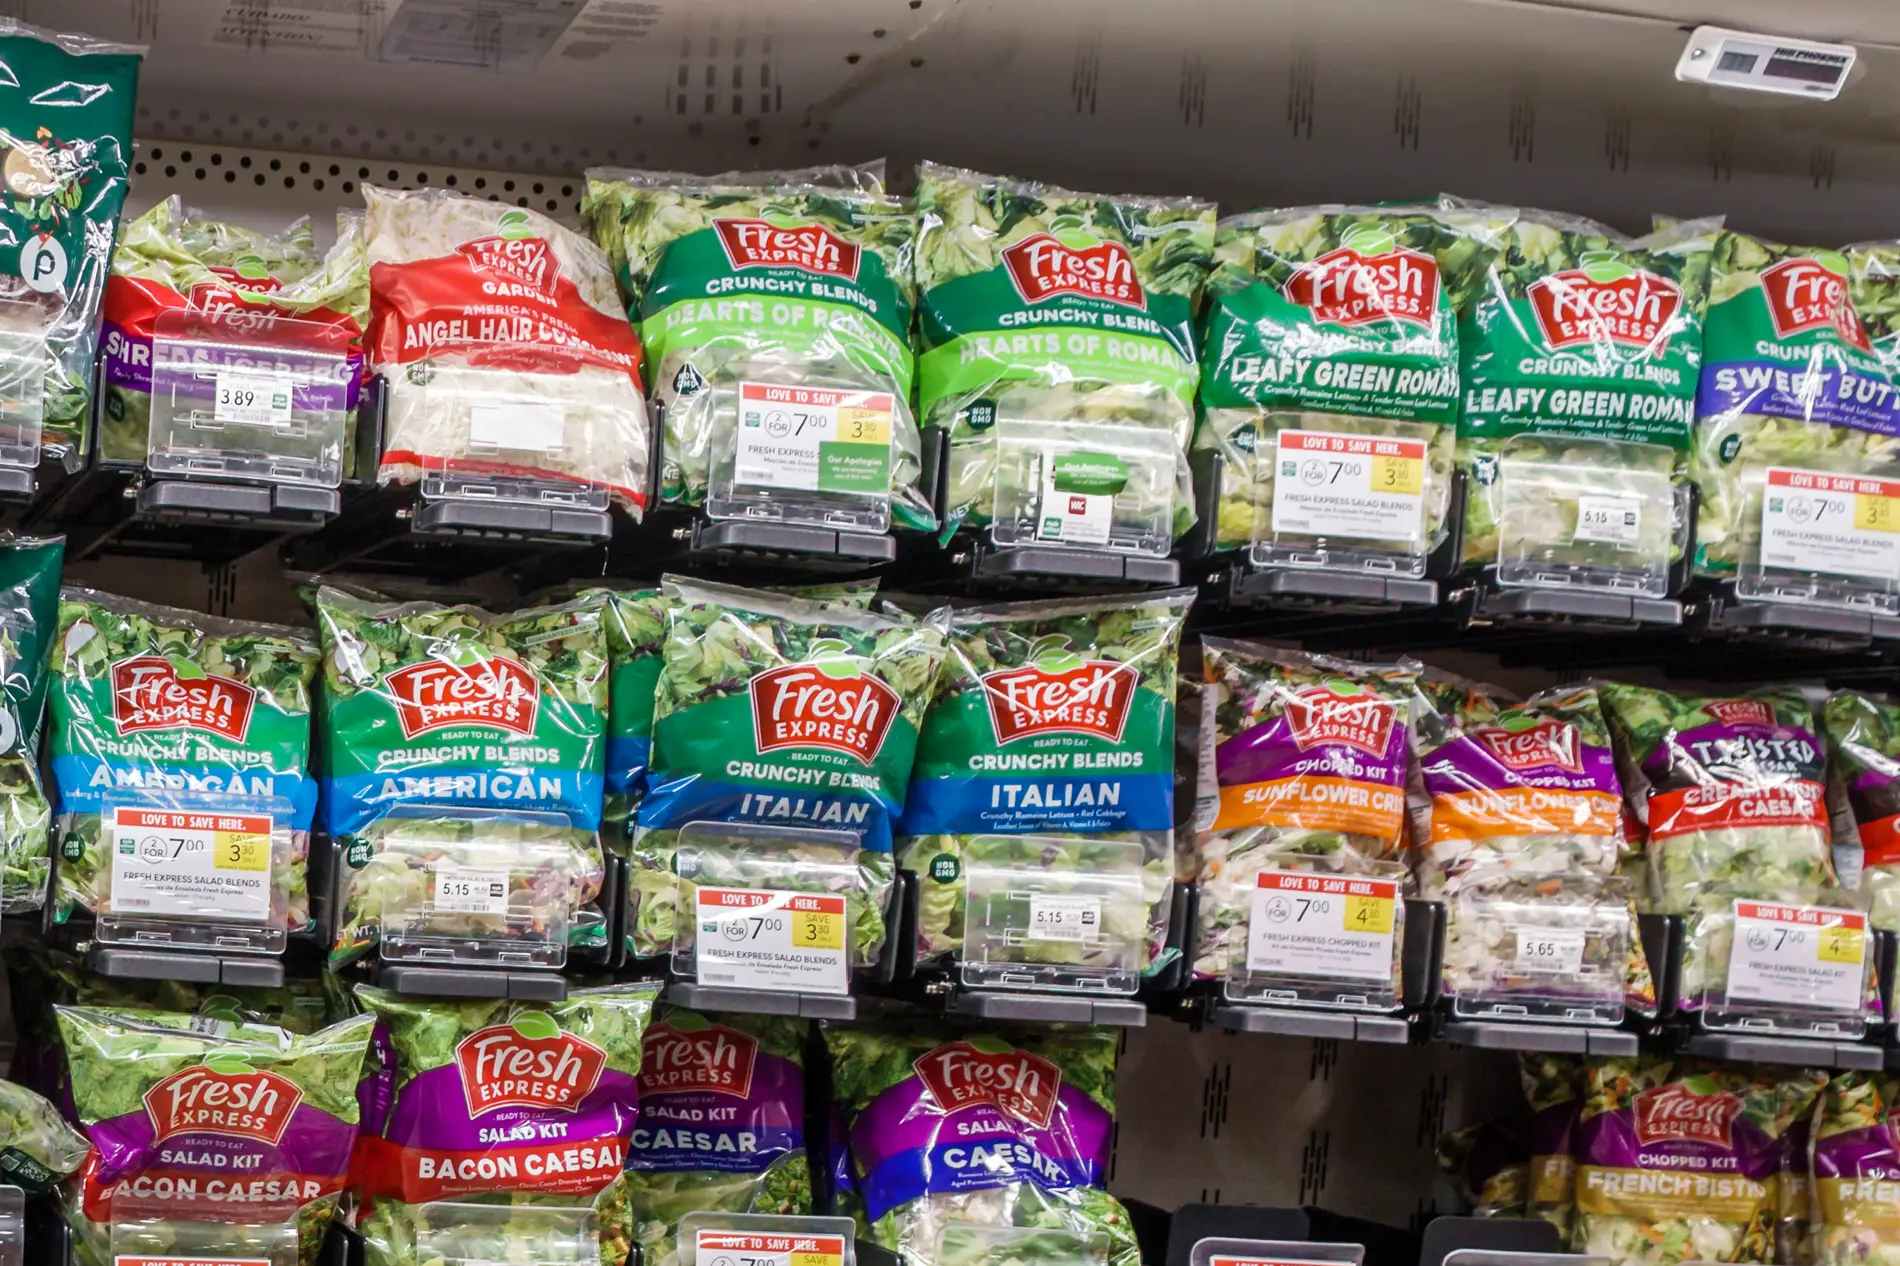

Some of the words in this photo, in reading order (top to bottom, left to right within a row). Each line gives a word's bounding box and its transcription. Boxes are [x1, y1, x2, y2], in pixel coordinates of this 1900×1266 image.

[738, 222, 840, 262] Fresh
[746, 247, 839, 273] EXPRESS
[405, 321, 473, 349] ANGEL
[479, 316, 531, 343] HAIR
[221, 389, 255, 407] 3.89
[1466, 390, 1545, 413] LEAFY
[1551, 390, 1623, 415] GREEN
[772, 675, 879, 730] Fresh
[1001, 669, 1117, 712] Fresh
[1014, 710, 1108, 729] EXPRESS
[776, 720, 868, 748] EXPRESS
[1034, 739, 1059, 747] READY
[968, 753, 1067, 770] CRUNCHY
[1073, 752, 1144, 769] BLENDS
[991, 782, 1121, 809] ITALIAN
[740, 794, 869, 823] ITALIAN
[935, 860, 955, 868] NON
[935, 869, 955, 877] GMO
[474, 1035, 584, 1080] Fresh
[480, 1080, 571, 1104] EXPRESS
[631, 1129, 757, 1153] CAESAR
[160, 1150, 223, 1166] SALAD
[233, 1154, 263, 1169] KIT
[419, 1155, 514, 1179] BACON
[1638, 1153, 1707, 1169] CHOPPED
[1712, 1156, 1738, 1168] KIT
[1587, 1172, 1690, 1196] FRENCH
